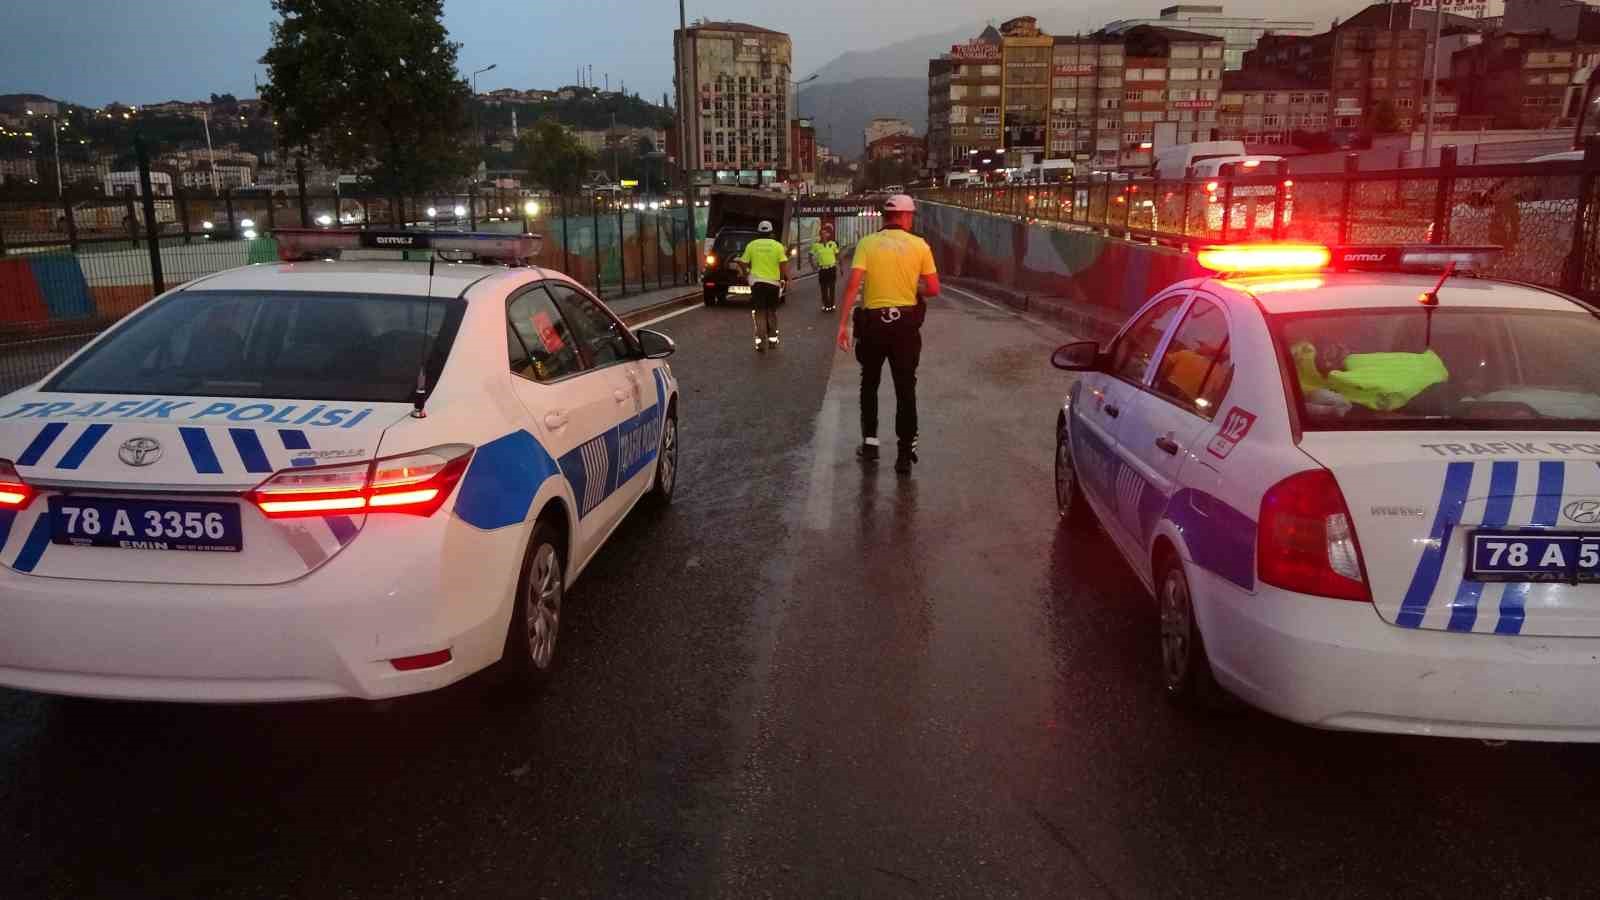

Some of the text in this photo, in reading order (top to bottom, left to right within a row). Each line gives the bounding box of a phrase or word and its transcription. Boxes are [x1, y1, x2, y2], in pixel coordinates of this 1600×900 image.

[2, 399, 372, 429] TRAFİK POLİSİ
[1223, 412, 1248, 439] 112
[1420, 441, 1600, 456] TRAFİK PO
[62, 507, 225, 539] 78 A 3356
[1486, 542, 1599, 567] 78 A 5
